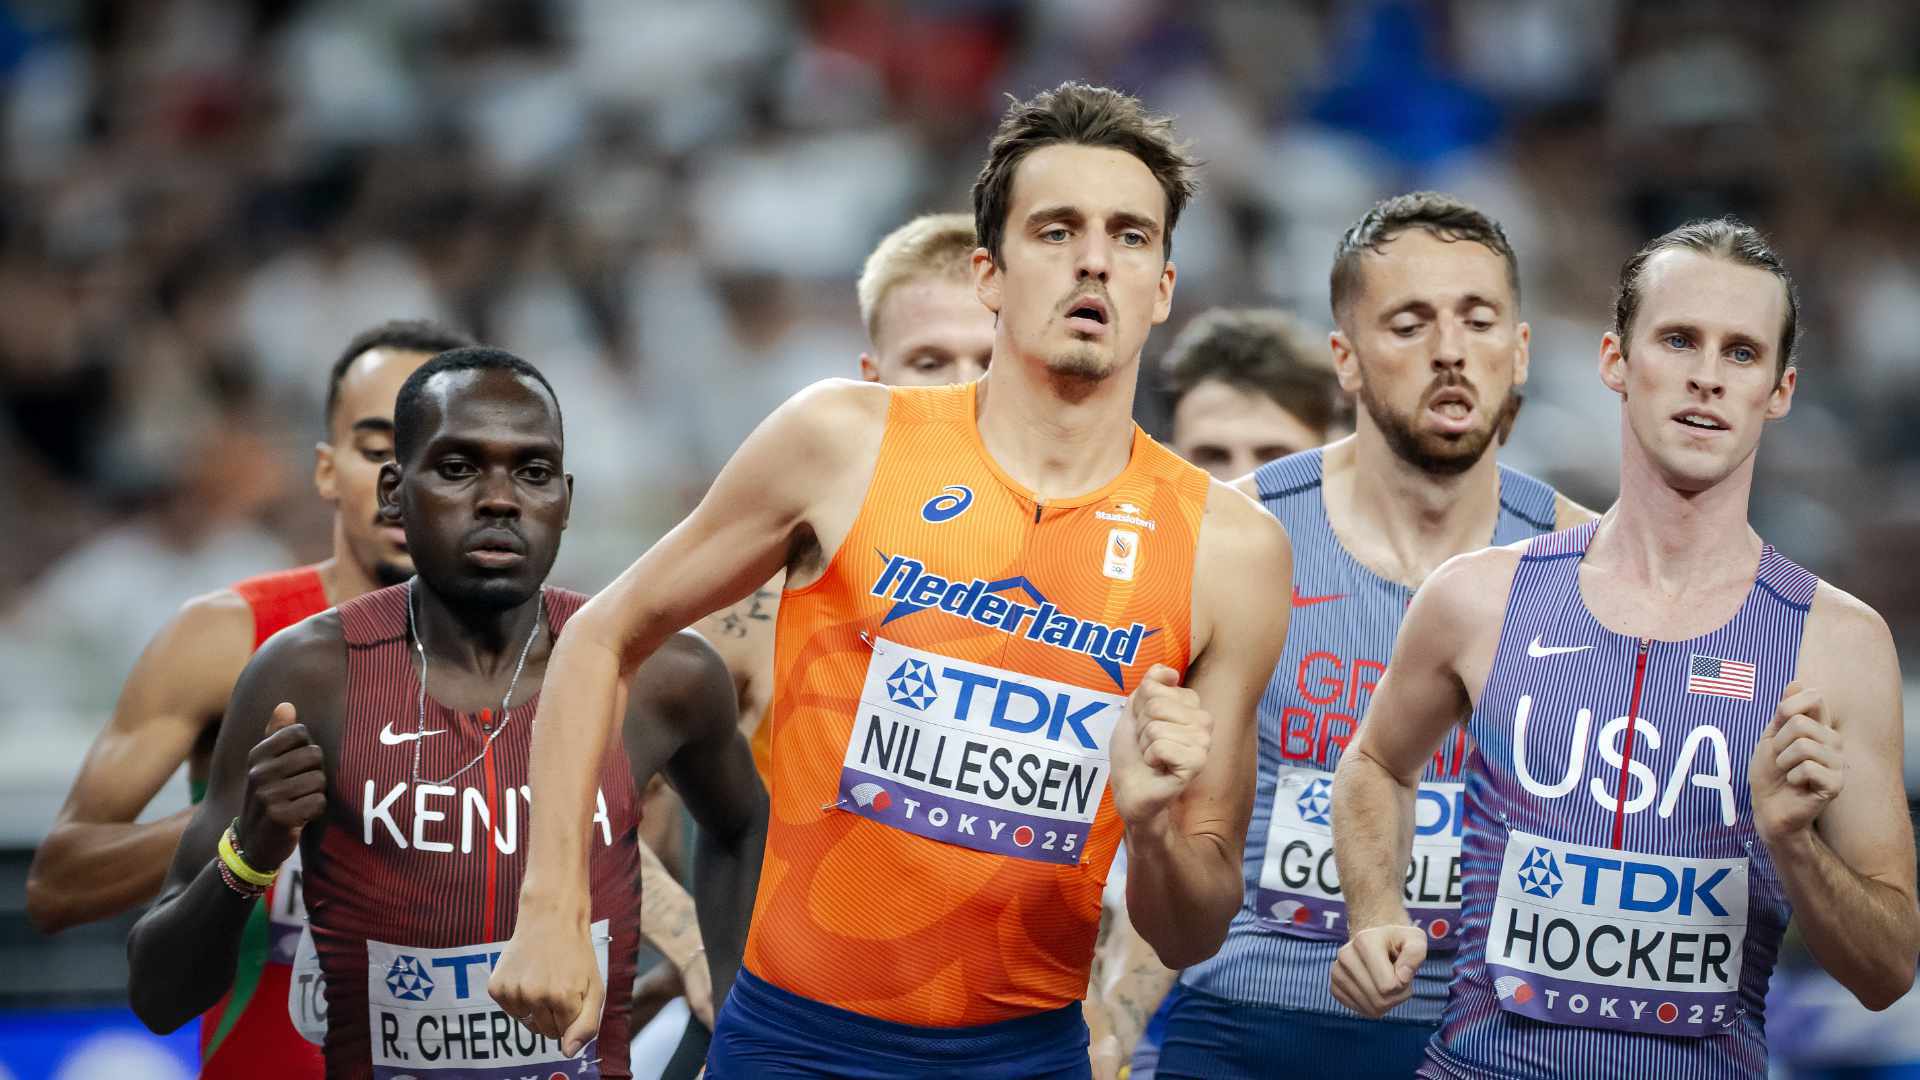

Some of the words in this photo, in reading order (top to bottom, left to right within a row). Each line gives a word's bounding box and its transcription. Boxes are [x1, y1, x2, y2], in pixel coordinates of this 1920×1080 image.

[871, 554, 1146, 666] Nederland
[941, 666, 1111, 750] TDK
[860, 714, 1099, 815] NILLESSEN
[1512, 694, 1737, 827] USA
[1564, 852, 1733, 917] TDK
[1503, 908, 1731, 984] HOCKER
[380, 1011, 409, 1061] R.
